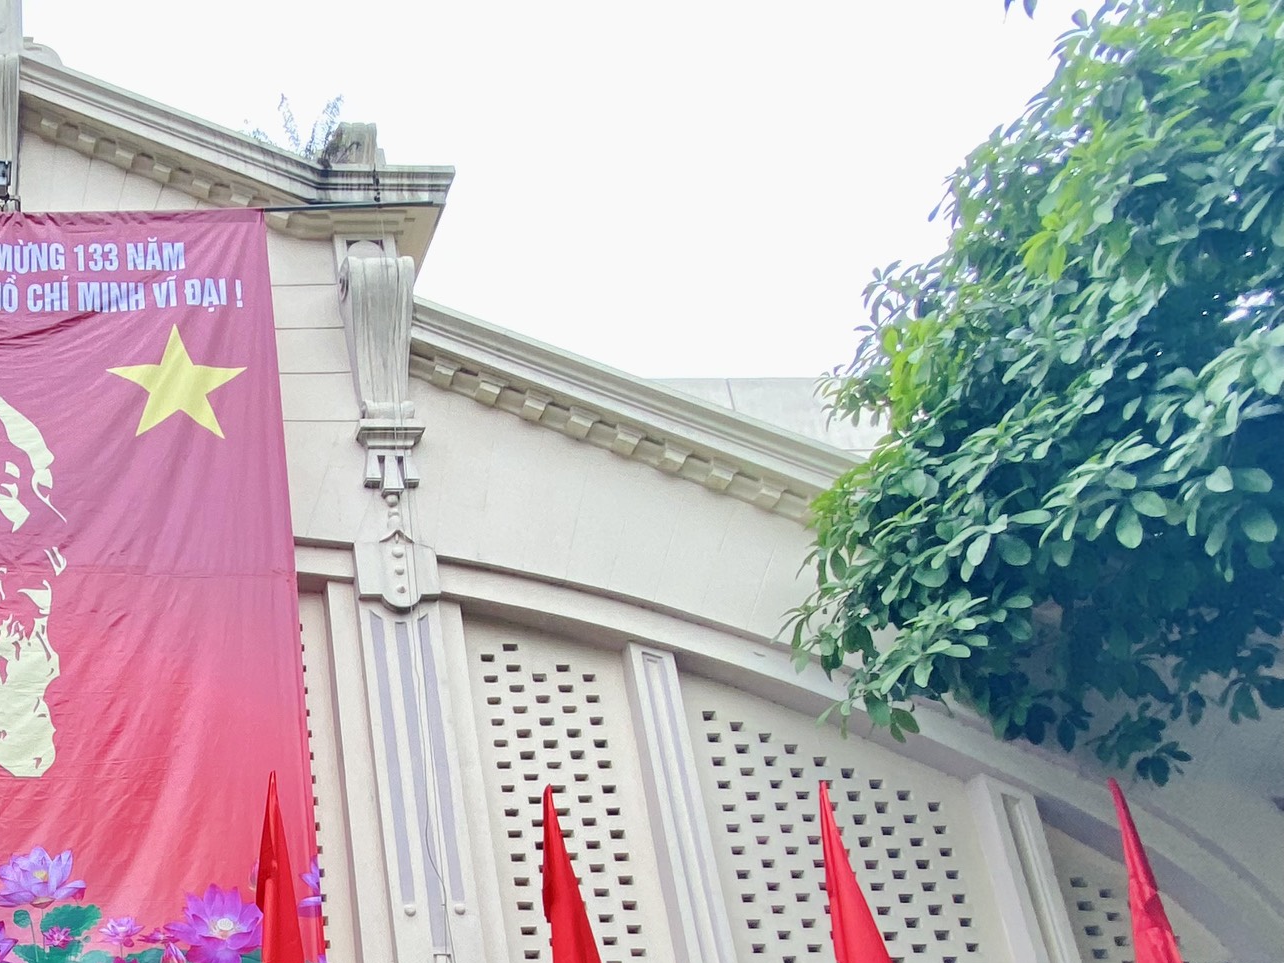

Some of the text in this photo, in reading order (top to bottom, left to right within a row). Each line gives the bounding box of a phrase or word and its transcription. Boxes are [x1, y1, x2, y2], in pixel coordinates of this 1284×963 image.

[73, 243, 119, 272] 133
[126, 237, 186, 271] NĂM
[27, 275, 69, 312] CHÍ
[77, 281, 146, 312] MINH
[152, 275, 178, 308] VĨ
[184, 278, 227, 312] ĐẠI
[235, 279, 244, 308] !
